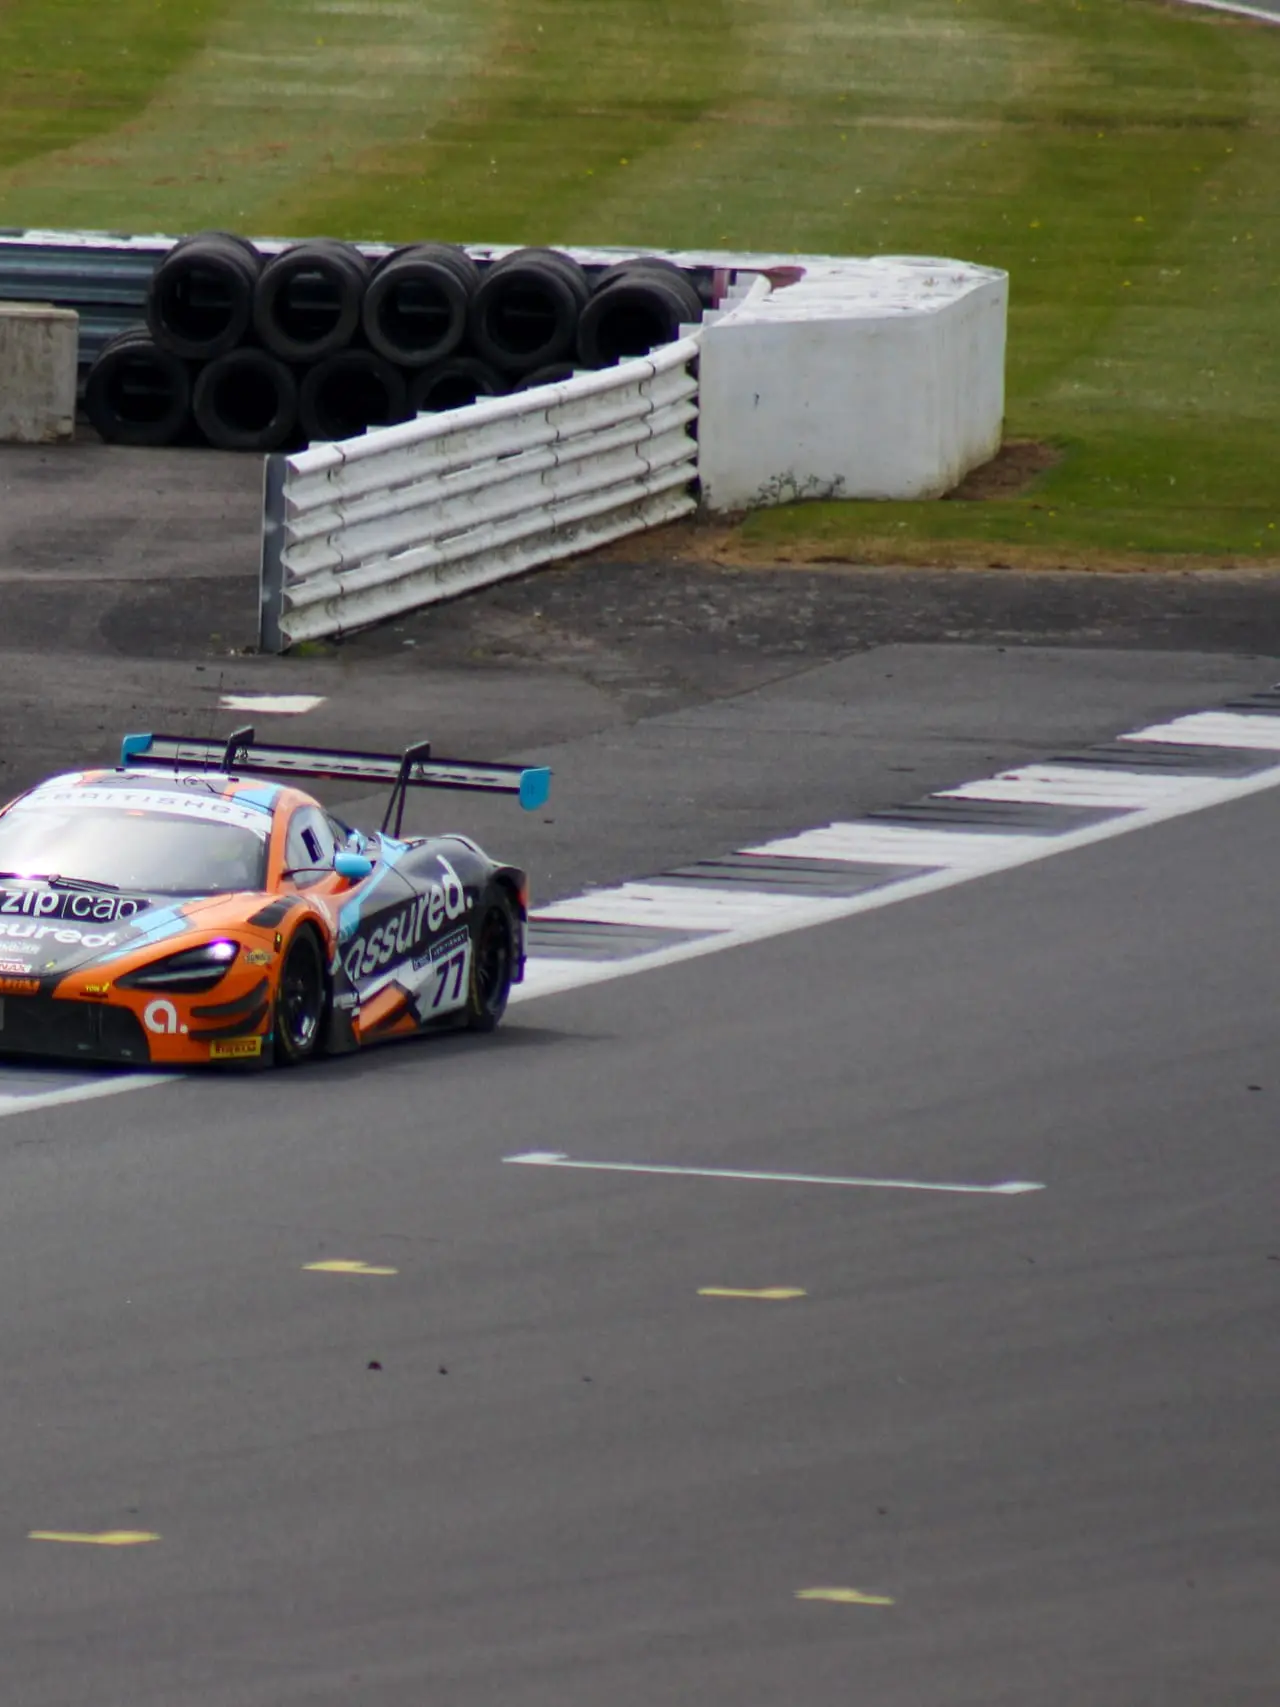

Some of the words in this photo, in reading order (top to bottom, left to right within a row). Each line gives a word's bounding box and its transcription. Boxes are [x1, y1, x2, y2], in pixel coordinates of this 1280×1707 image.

[344, 854, 473, 983] assured.
[432, 950, 465, 1008] 77
[144, 999, 188, 1034] a.
